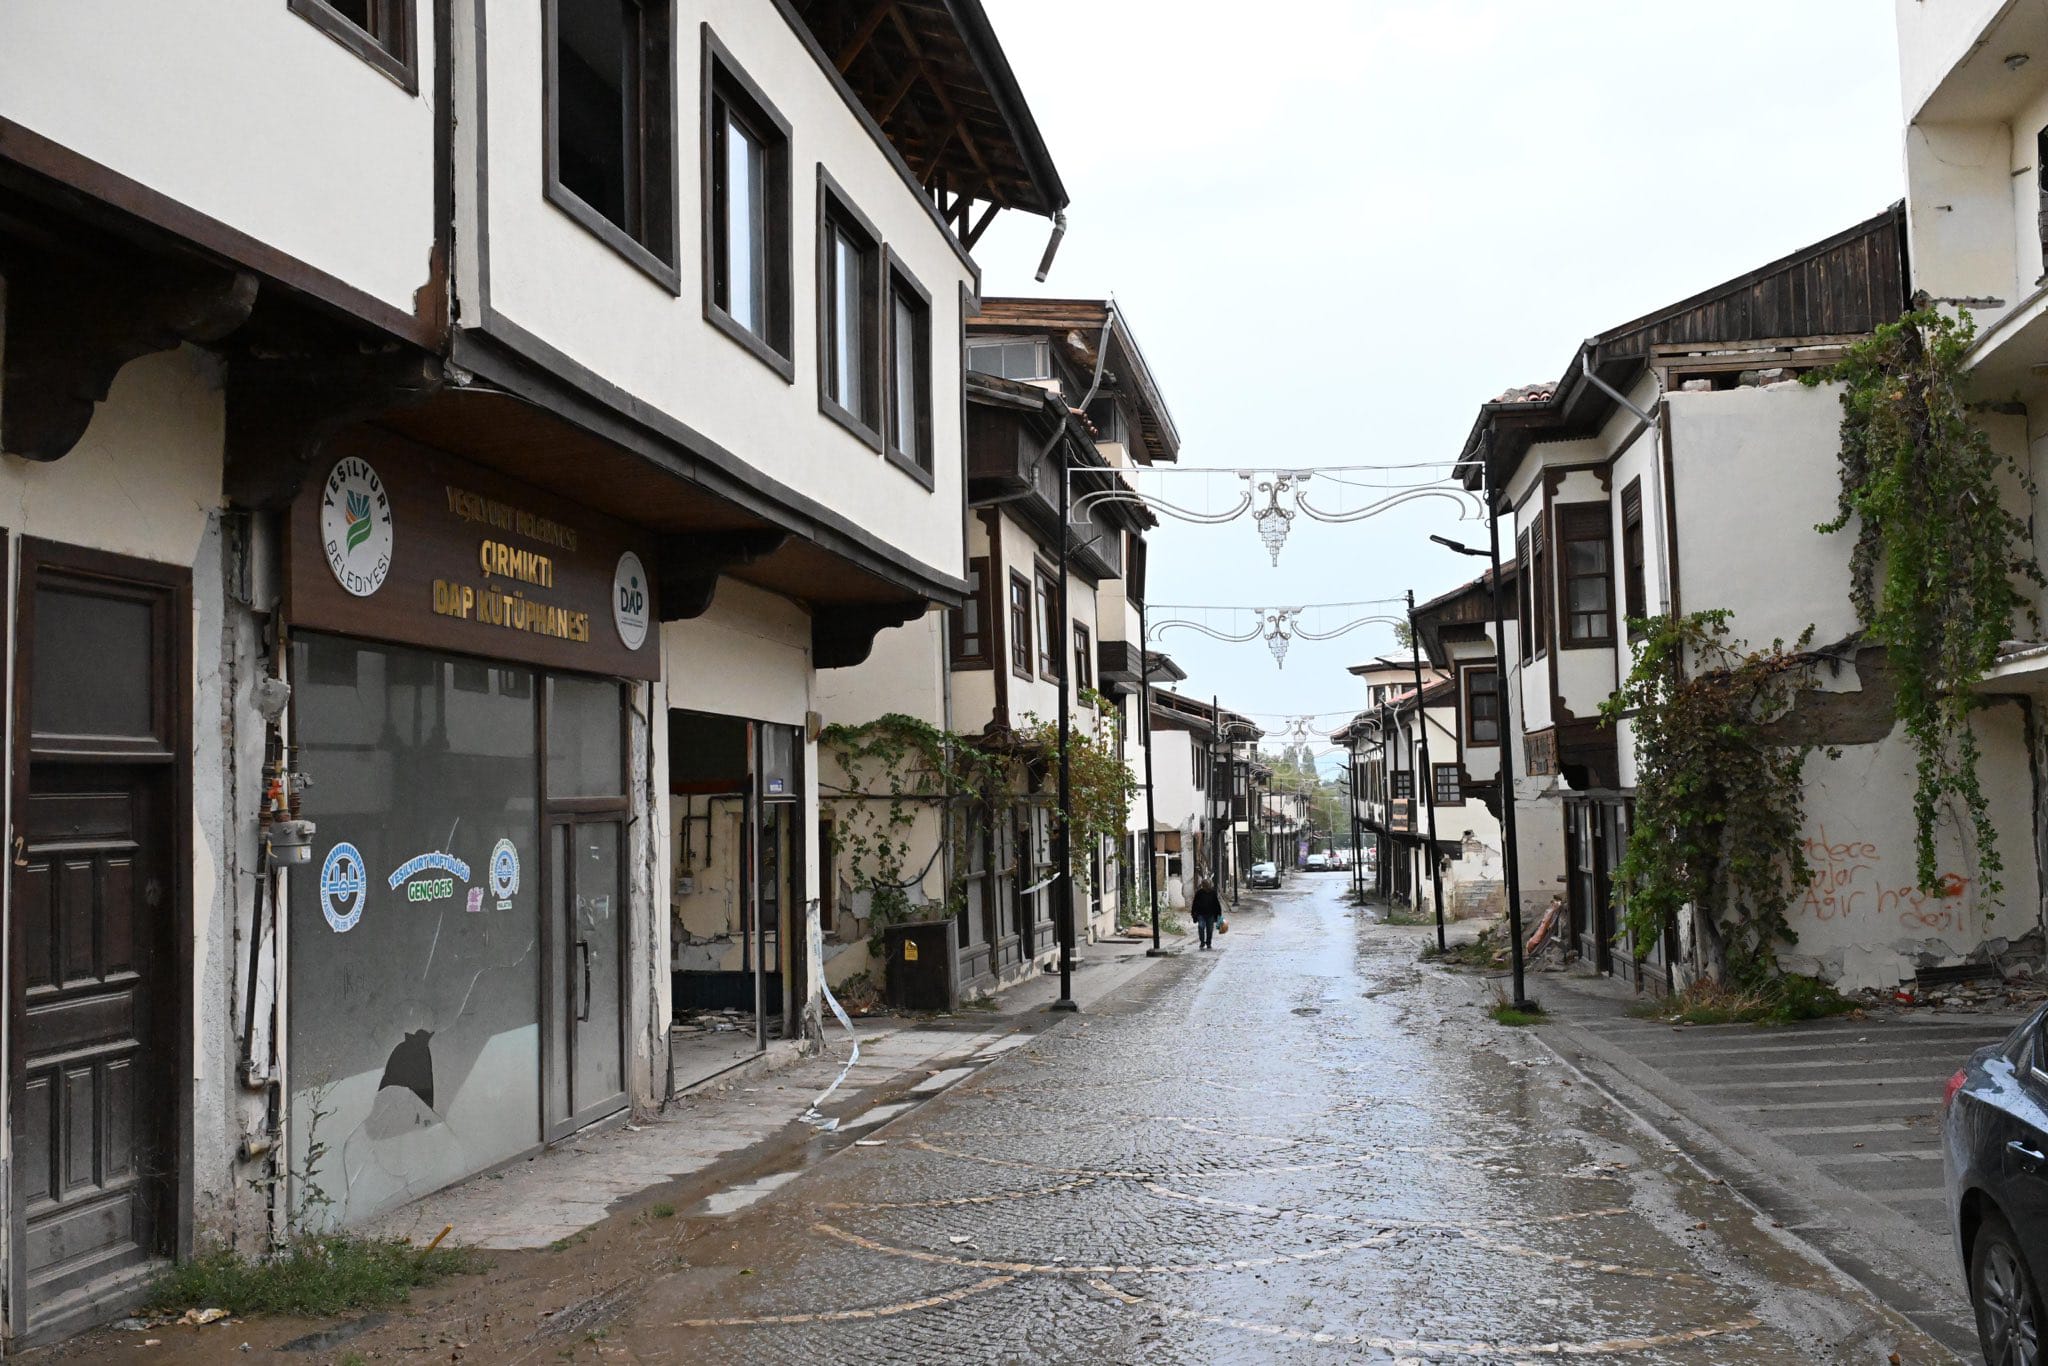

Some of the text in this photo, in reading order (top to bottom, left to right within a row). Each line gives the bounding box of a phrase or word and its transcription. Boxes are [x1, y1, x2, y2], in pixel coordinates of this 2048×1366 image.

[325, 460, 391, 525] YEŞİLYURT
[327, 540, 390, 593] BELEDİYESİ
[479, 539, 553, 588] ÇIRMIKTI
[433, 578, 590, 643] DAP KÜTÜPHANESİ
[620, 586, 643, 616] DAP
[388, 855, 428, 888] YEŞİLYURT
[428, 850, 470, 882] MÜFTÜLÜĞÜ
[408, 878, 453, 901] GENÇ OFİS
